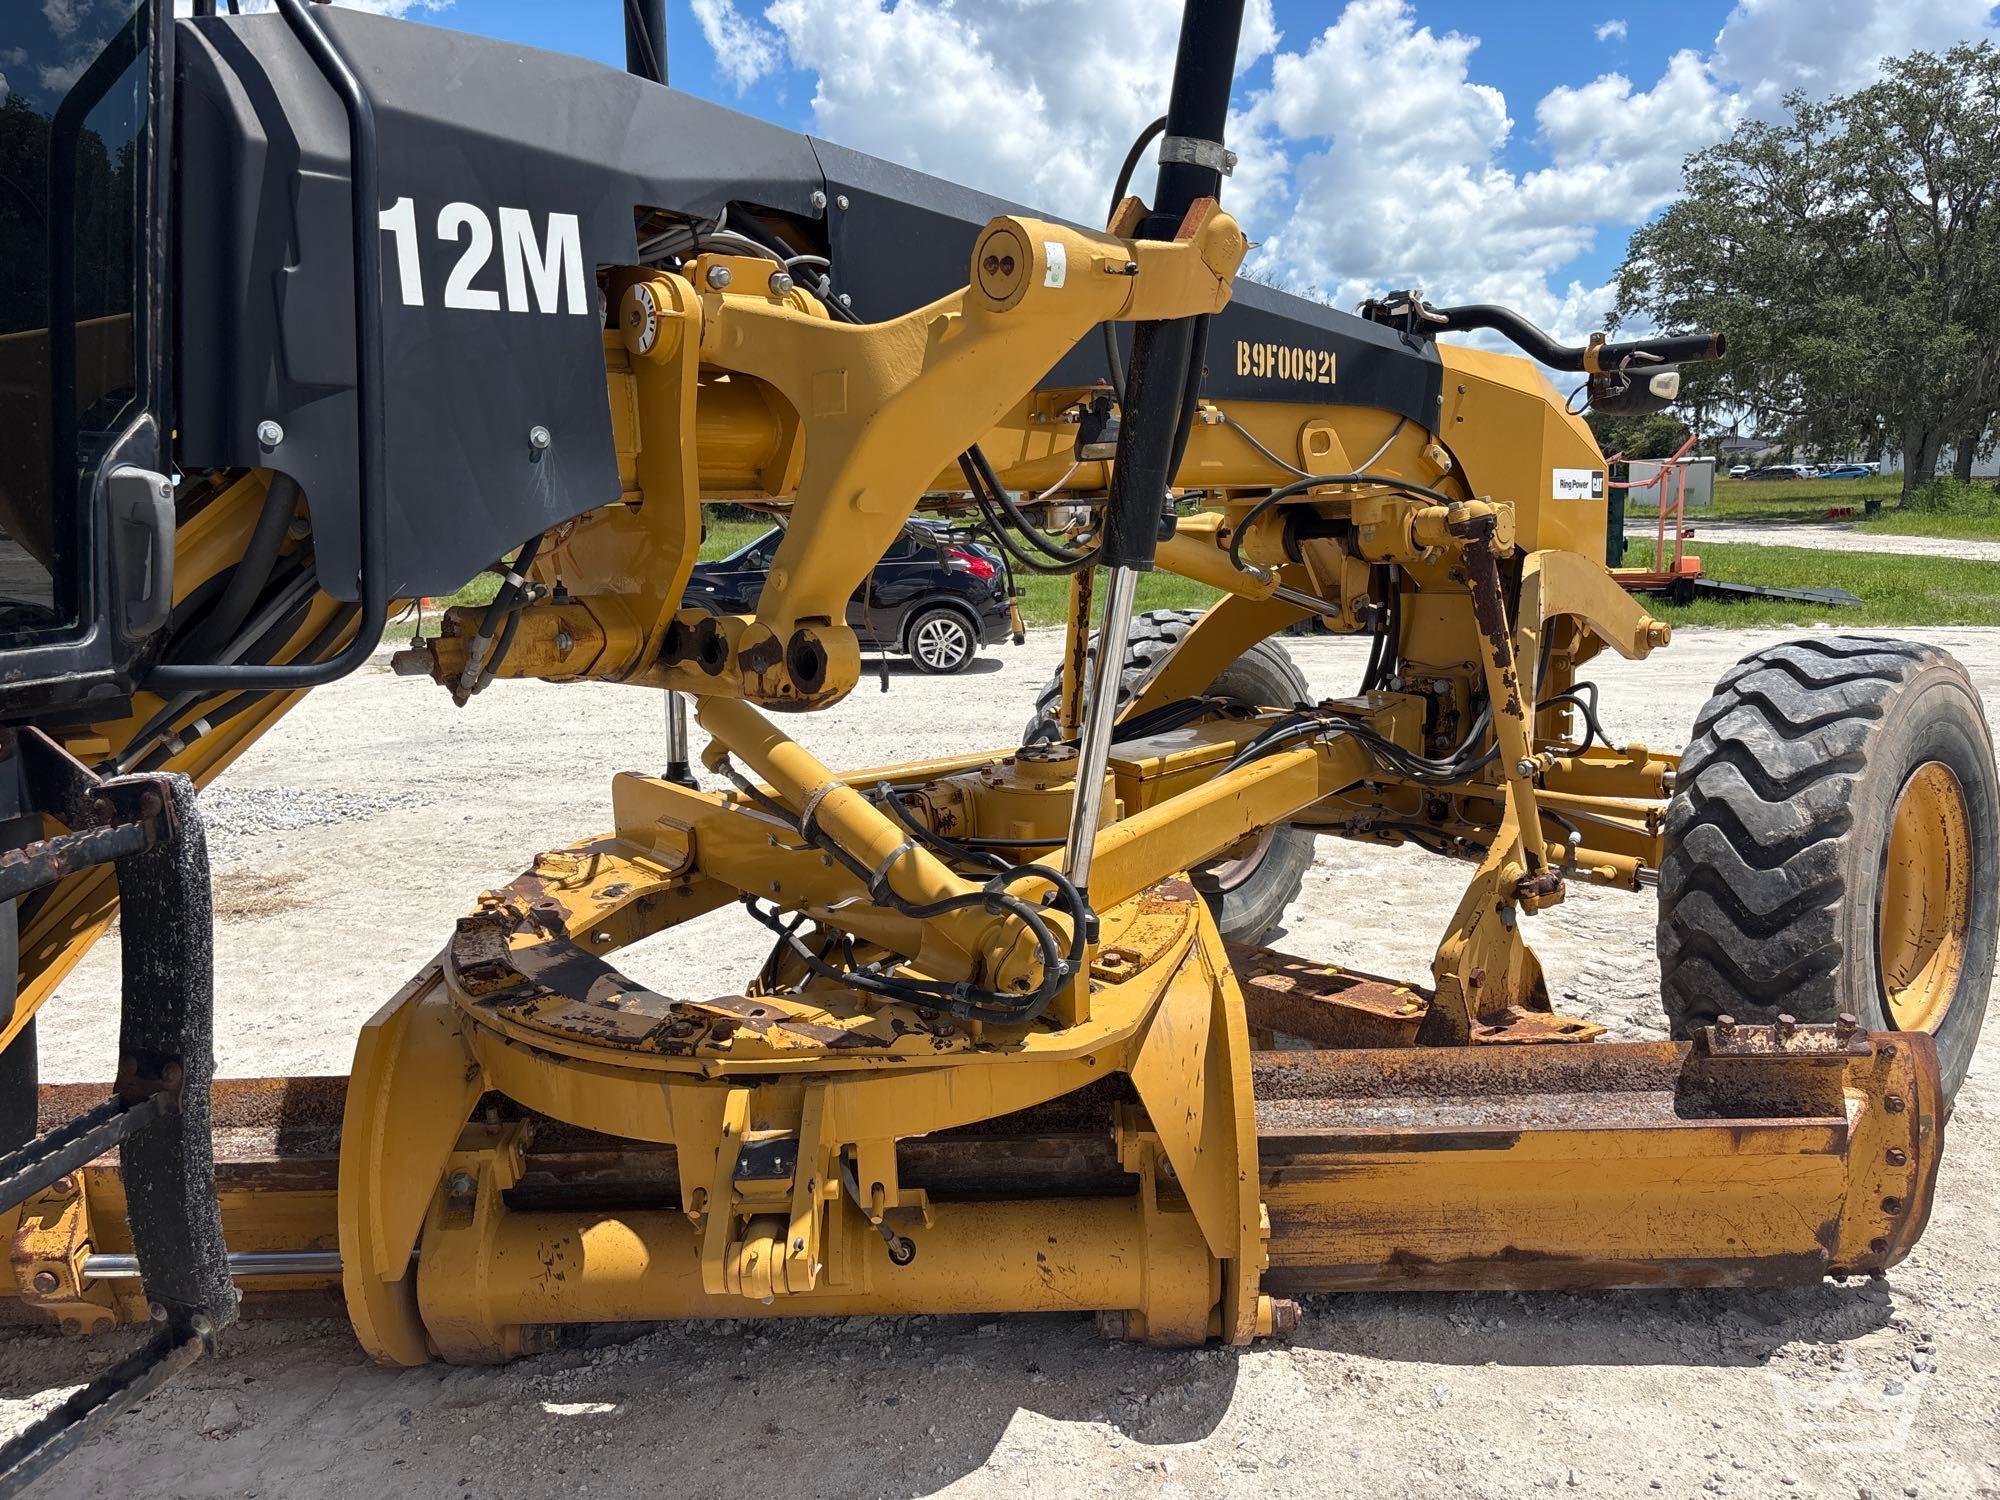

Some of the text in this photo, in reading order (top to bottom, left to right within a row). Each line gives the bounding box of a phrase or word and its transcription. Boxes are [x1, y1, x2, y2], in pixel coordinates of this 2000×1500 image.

[379, 196, 588, 315] 12M
[1237, 340, 1336, 384] B9F00921
[1560, 479, 1589, 491] Ring Power
